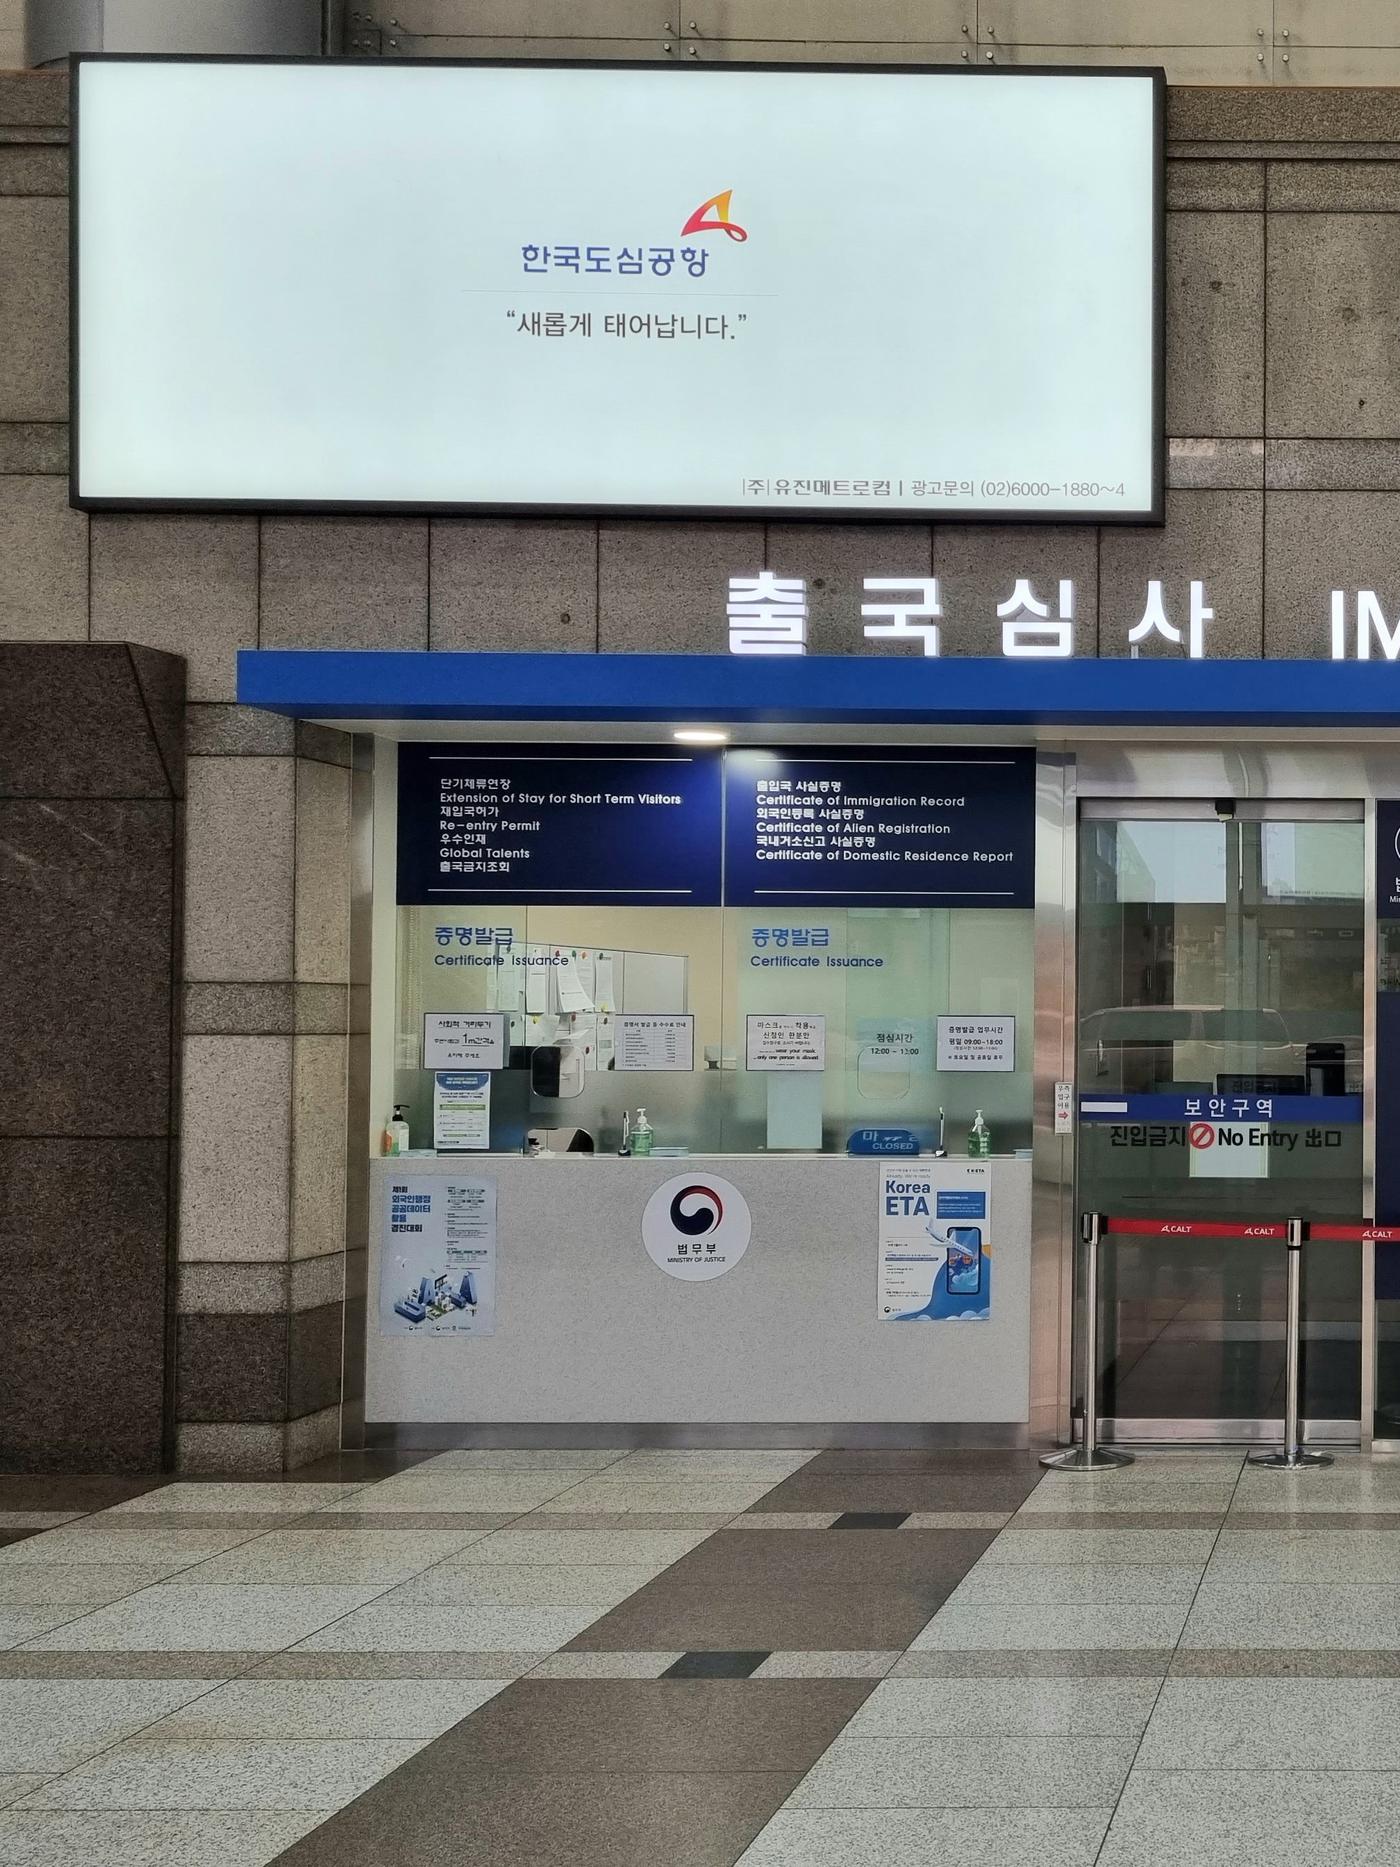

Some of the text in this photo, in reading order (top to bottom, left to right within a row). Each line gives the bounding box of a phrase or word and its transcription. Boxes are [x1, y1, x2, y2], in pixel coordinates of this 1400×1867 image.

[521, 244, 709, 277] 한국도심공항
[911, 481, 975, 498] 광고문의
[440, 778, 511, 790] 단기체류연장
[756, 780, 842, 792] 출입국 사실증명
[440, 792, 682, 805] Extension of Stay for Short Term Visitors
[756, 795, 965, 808] Certificate of Immigration Record
[440, 806, 500, 817] 재입국허가
[756, 808, 865, 820] 외국인등록 사실증명
[501, 820, 541, 831] Permit
[756, 823, 951, 835] Certificate of Alien Registration
[440, 833, 487, 845] 우수인재
[756, 836, 876, 848] 국내거소신고 사실증명
[440, 847, 530, 859] Global Talents
[756, 850, 1014, 863] Certificate of Domestic Residence Report
[440, 861, 510, 873] 출국금지조회
[434, 927, 513, 946] 증명발급
[751, 928, 829, 948] 증명발급
[434, 954, 570, 966] Certificate Issuance
[750, 955, 884, 968] Certificate Issuance
[1184, 1098, 1273, 1118] 보안구역
[1110, 1125, 1342, 1151] 진입금지 No Entry 出口
[872, 1142, 914, 1150] CLOSED
[885, 1180, 931, 1194] Korea
[885, 1196, 930, 1216] ETA
[677, 1243, 716, 1255] 법무부
